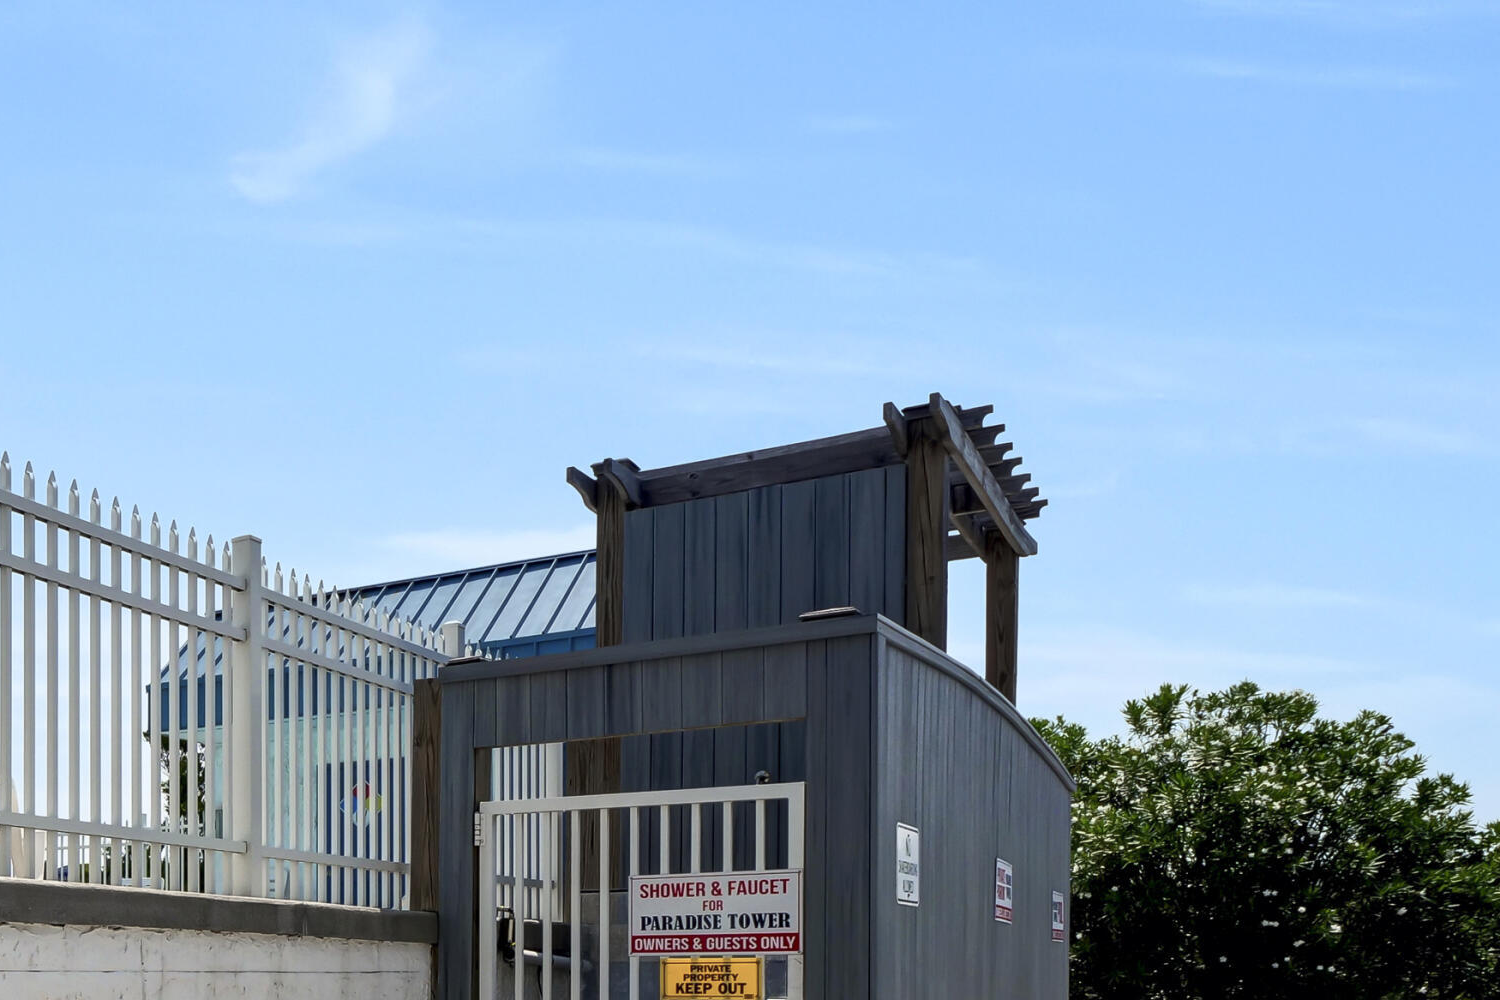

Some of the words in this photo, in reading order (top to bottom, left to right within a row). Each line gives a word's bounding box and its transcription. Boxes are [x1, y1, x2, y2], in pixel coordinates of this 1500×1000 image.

[640, 882, 706, 898] SHOWER
[711, 881, 722, 896] &
[728, 879, 790, 895] FAUCET
[703, 900, 723, 911] FOR
[641, 914, 722, 931] PARADISE
[728, 912, 790, 929] TOWER
[635, 937, 689, 950] OWNERS
[692, 938, 702, 950] &
[706, 937, 757, 950] GUESTS
[761, 936, 796, 949] ONLY
[690, 965, 731, 973] PRIVATE
[683, 973, 739, 981] PROPERTY
[676, 983, 713, 994] KEEP
[718, 983, 747, 994] OUT
